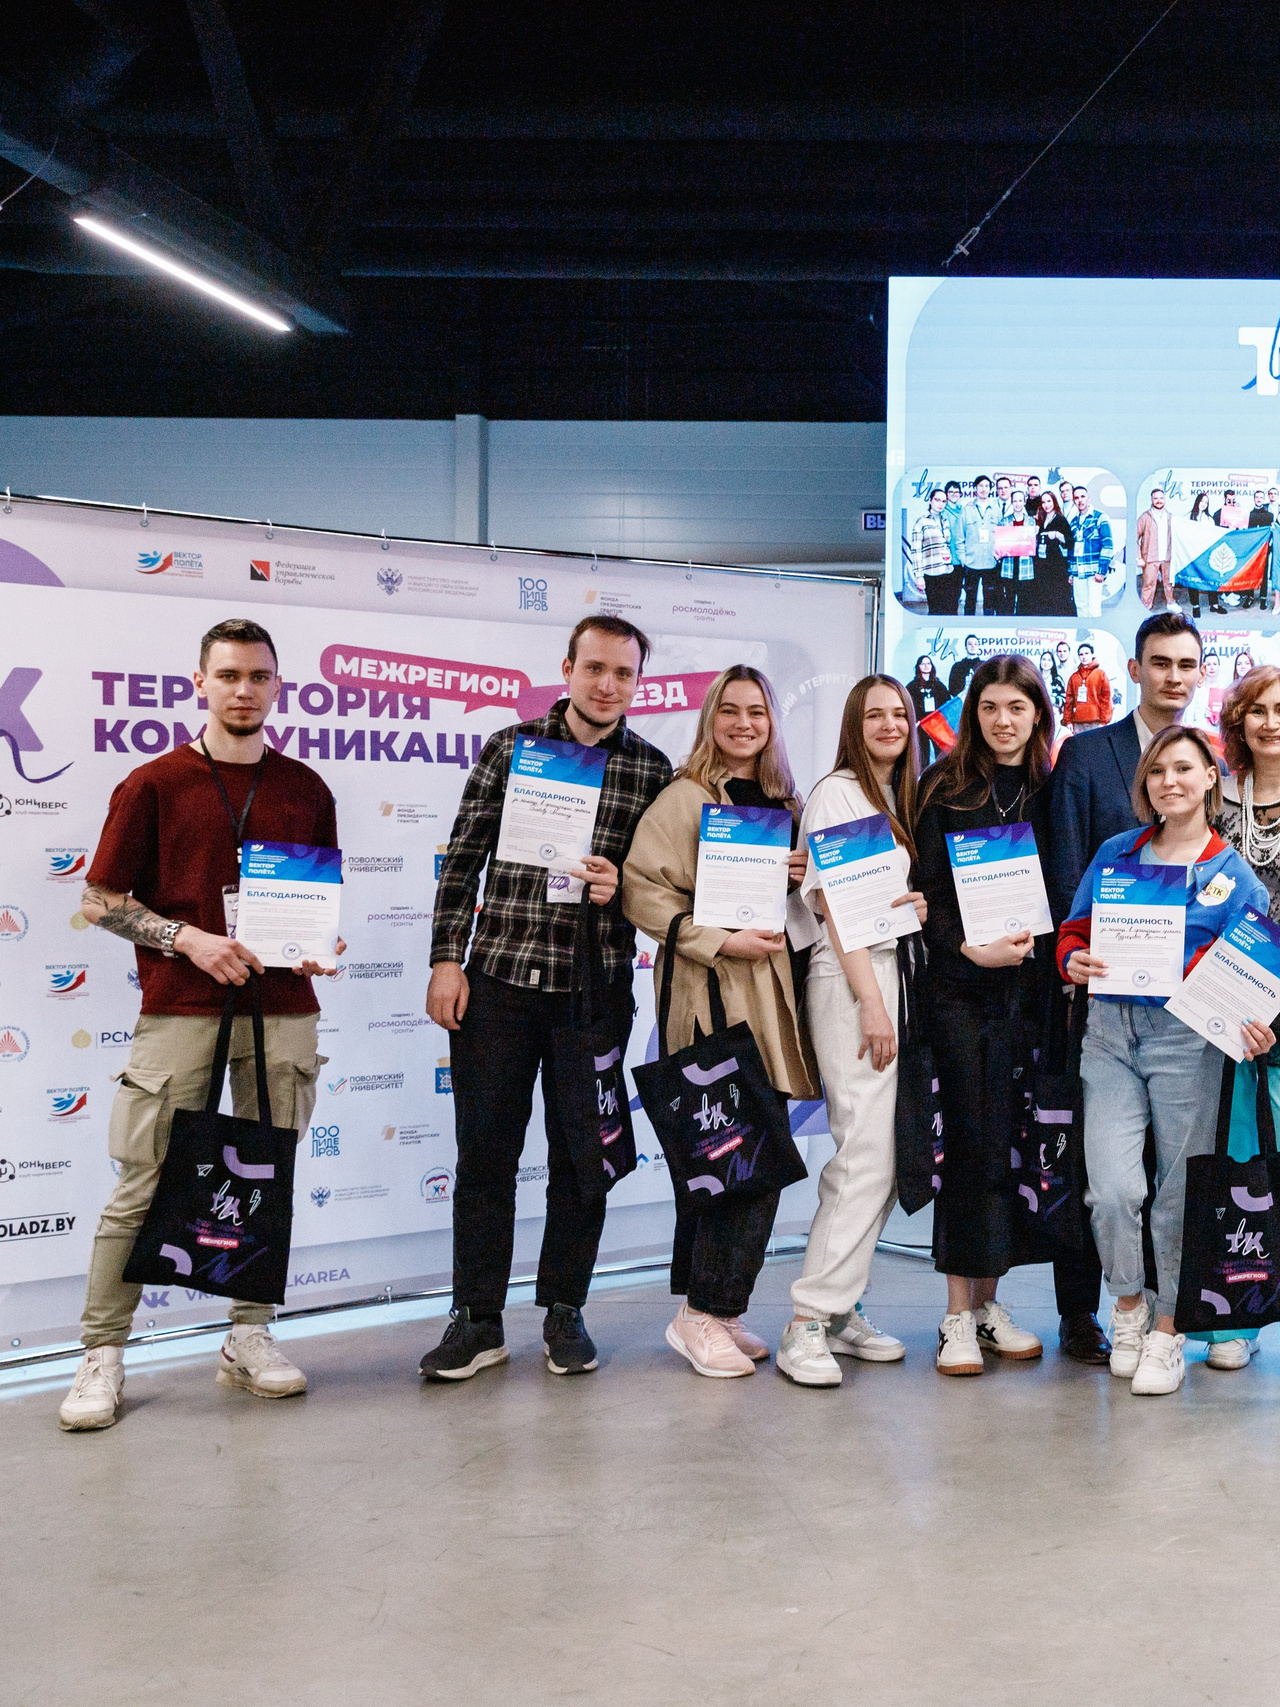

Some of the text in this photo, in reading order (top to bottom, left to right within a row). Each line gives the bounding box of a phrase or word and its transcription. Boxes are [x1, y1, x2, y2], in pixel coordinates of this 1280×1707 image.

[173, 551, 202, 559] ВЕКТОР
[173, 559, 203, 568] ПОЛЁТА
[275, 560, 316, 570] Федерация
[275, 569, 335, 581] управленческой
[518, 577, 548, 591] 100
[672, 604, 737, 616] росмолодёжь
[977, 638, 1042, 646] ЕРРИТОРИЯ
[334, 654, 520, 699] МЕЖРЕГИОН
[92, 671, 431, 720] ТЕРТОРИЯ
[518, 759, 543, 767] ВЕКТОР
[514, 787, 586, 805] БЛАГОДАРНОСТЬ
[819, 850, 841, 860] ВЕКТОР
[956, 849, 979, 857] ВЕКТОР
[349, 856, 404, 864] ПОВОЛЖСКИЙ
[705, 854, 777, 865] БЛАГОДАРНОСТЬ
[827, 864, 891, 888] БЛАГОДАРНОСТЬ
[961, 868, 1030, 884] БЛАГОДАРНОСТЬ
[247, 890, 327, 901] БЛАГОДАРНОСТЬ
[1099, 916, 1173, 926] БЛАГОДАРНОСТЬ
[1233, 928, 1256, 945] ВЕКТОР
[349, 961, 404, 970] ПОВОЛЖСКИЙ
[349, 971, 403, 979] УНИВЕРСИТЕТ
[1214, 951, 1277, 999] БЛАГОДАРНОСТЬ
[349, 1072, 404, 1082] ПОВОЛЖСКИЙ
[350, 1082, 404, 1092] УНИВЕРСИТЕТ
[311, 1125, 340, 1139] 100
